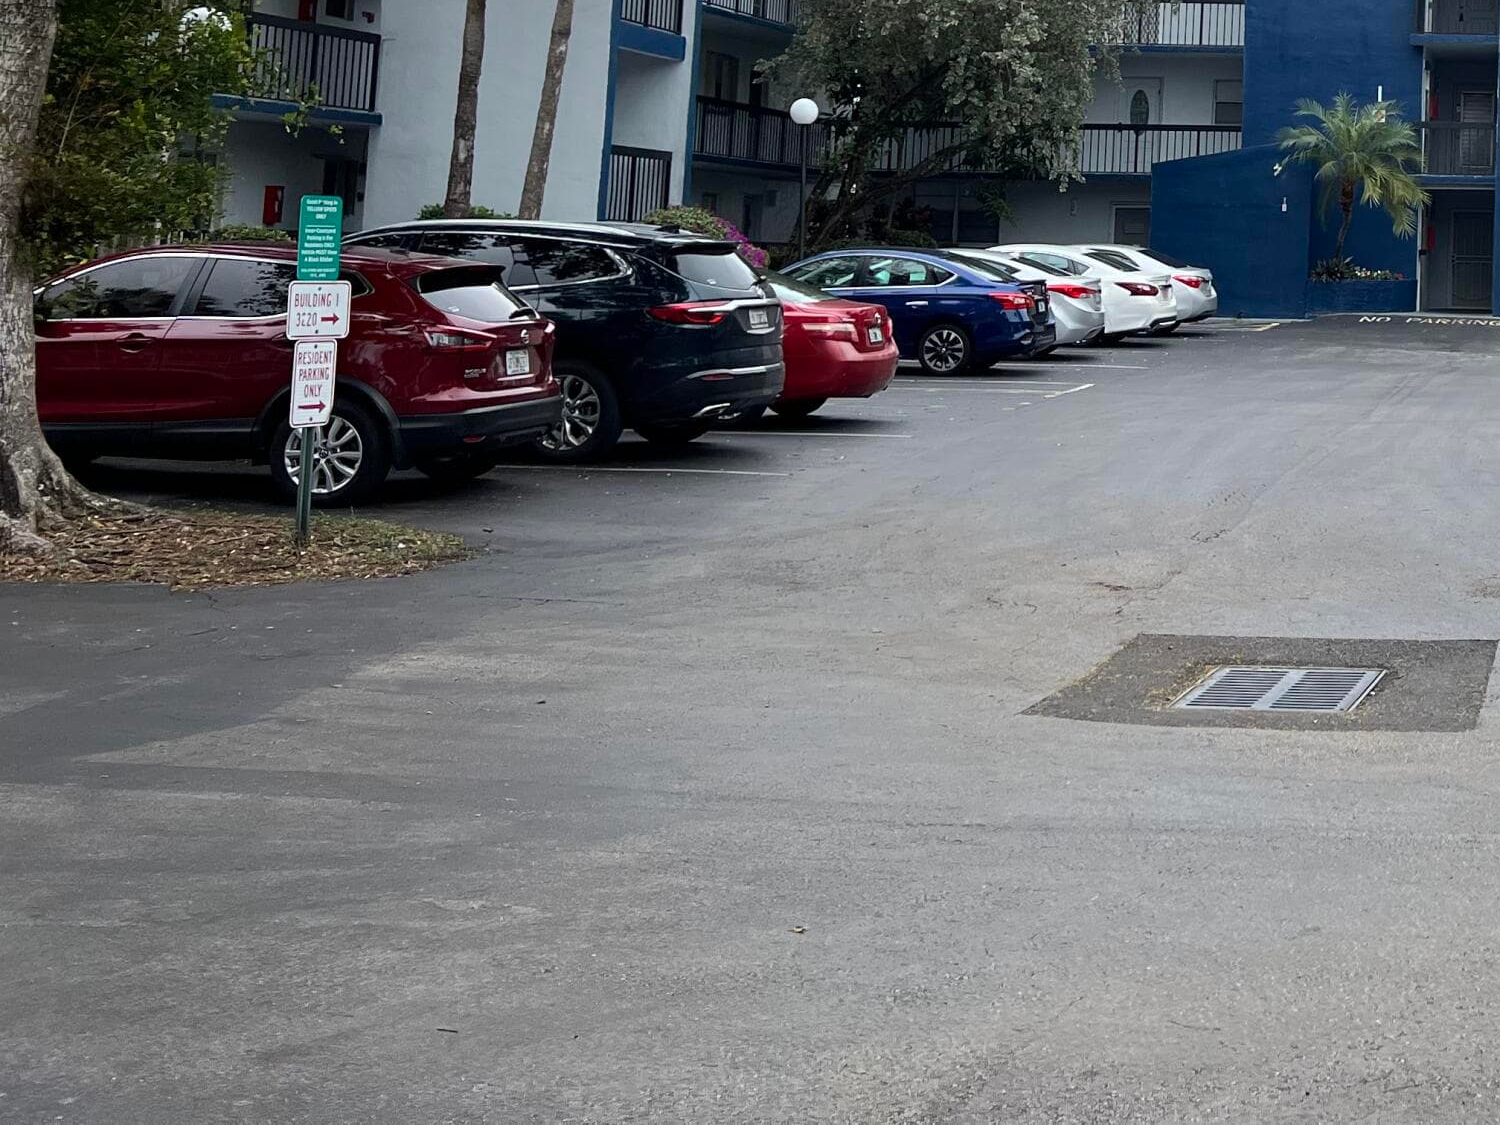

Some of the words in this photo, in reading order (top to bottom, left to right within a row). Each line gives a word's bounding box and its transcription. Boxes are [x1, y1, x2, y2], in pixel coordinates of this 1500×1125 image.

[294, 293, 332, 307] BUILDING
[296, 312, 317, 327] 3220
[297, 351, 332, 365] RESIDENT
[299, 367, 330, 381] PARKING
[303, 384, 323, 398] ONLY
